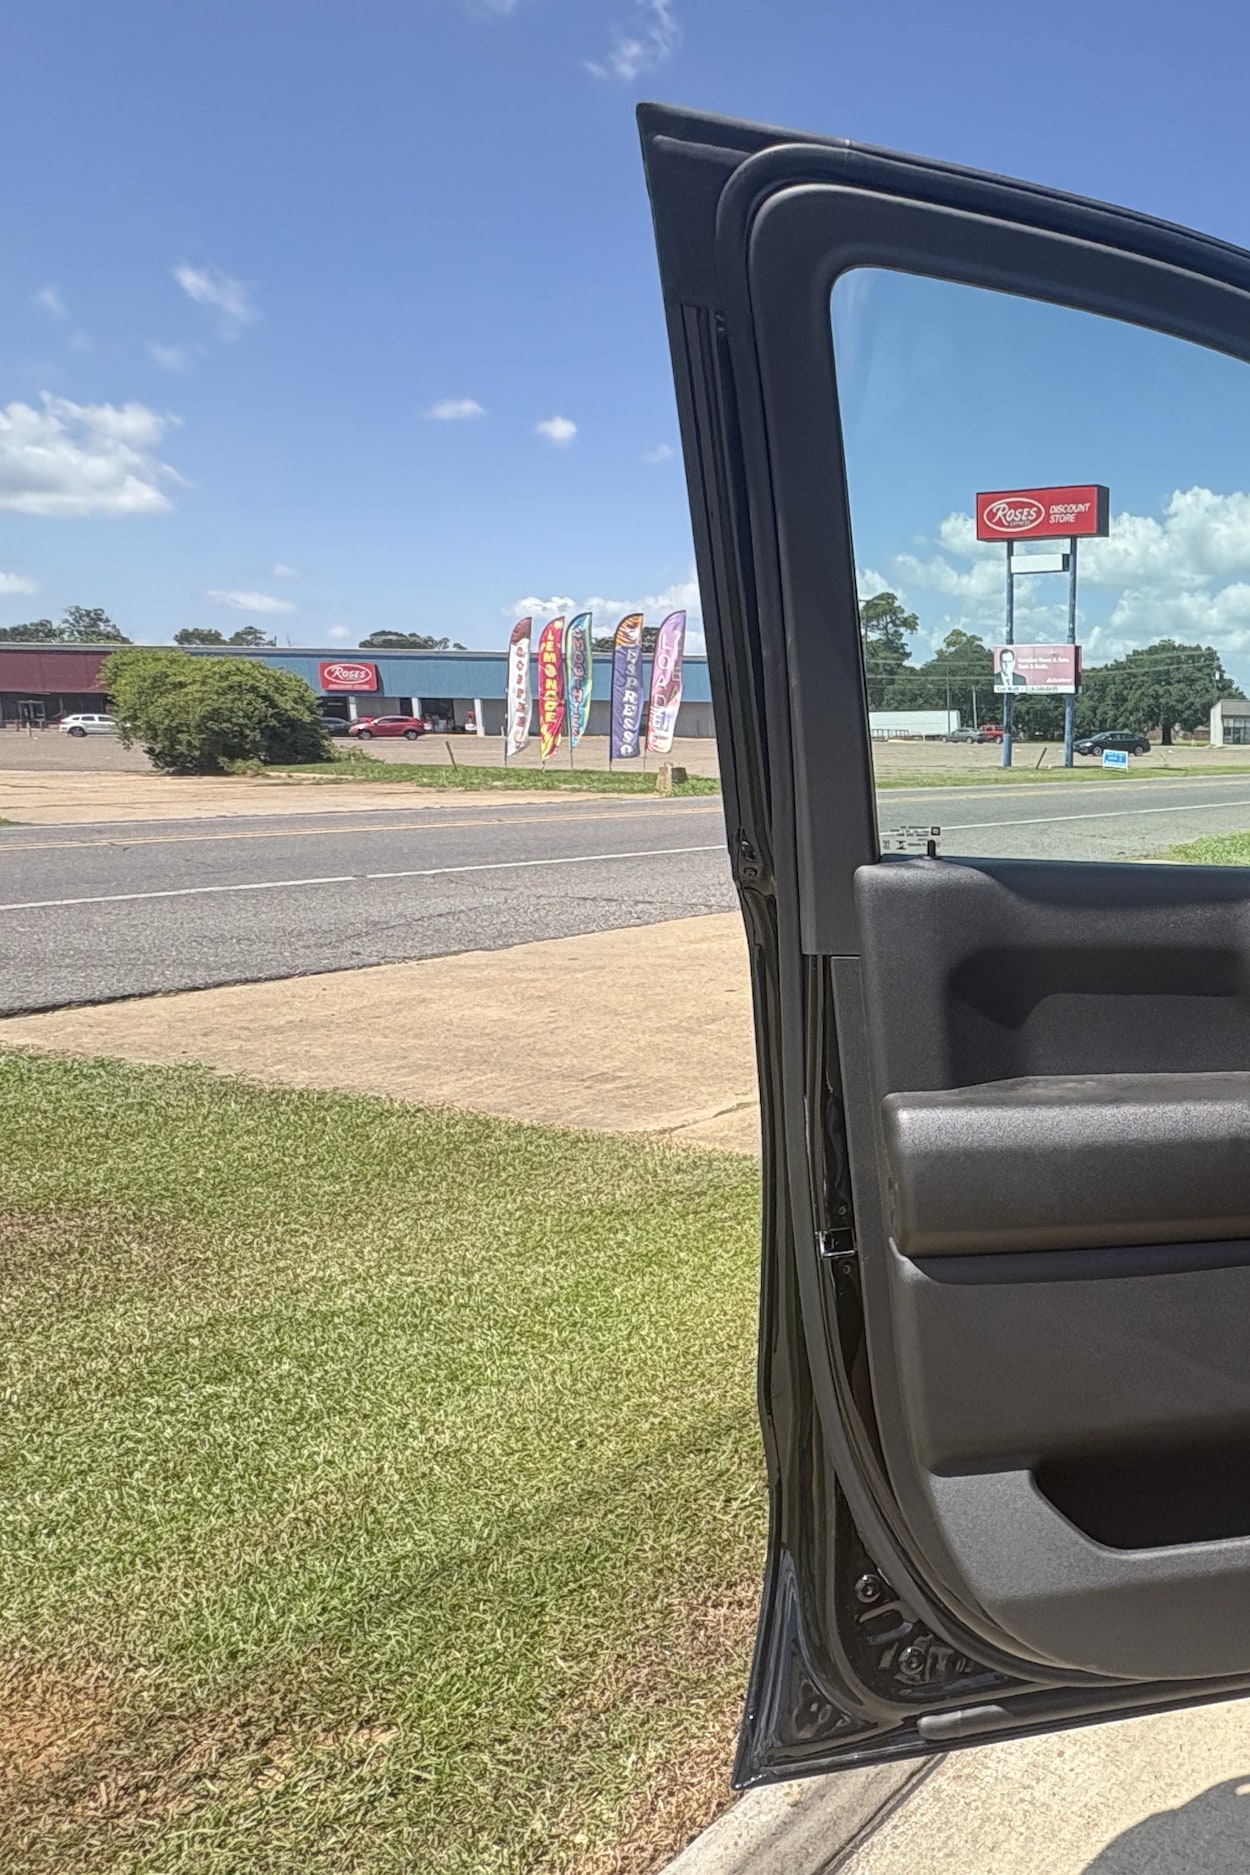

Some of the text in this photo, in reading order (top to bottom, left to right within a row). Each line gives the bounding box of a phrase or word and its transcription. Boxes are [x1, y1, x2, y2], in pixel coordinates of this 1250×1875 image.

[1049, 503, 1091, 514] DISCOUNT
[1049, 514, 1076, 524] STORE
[620, 649, 638, 756] ESPRESSO
